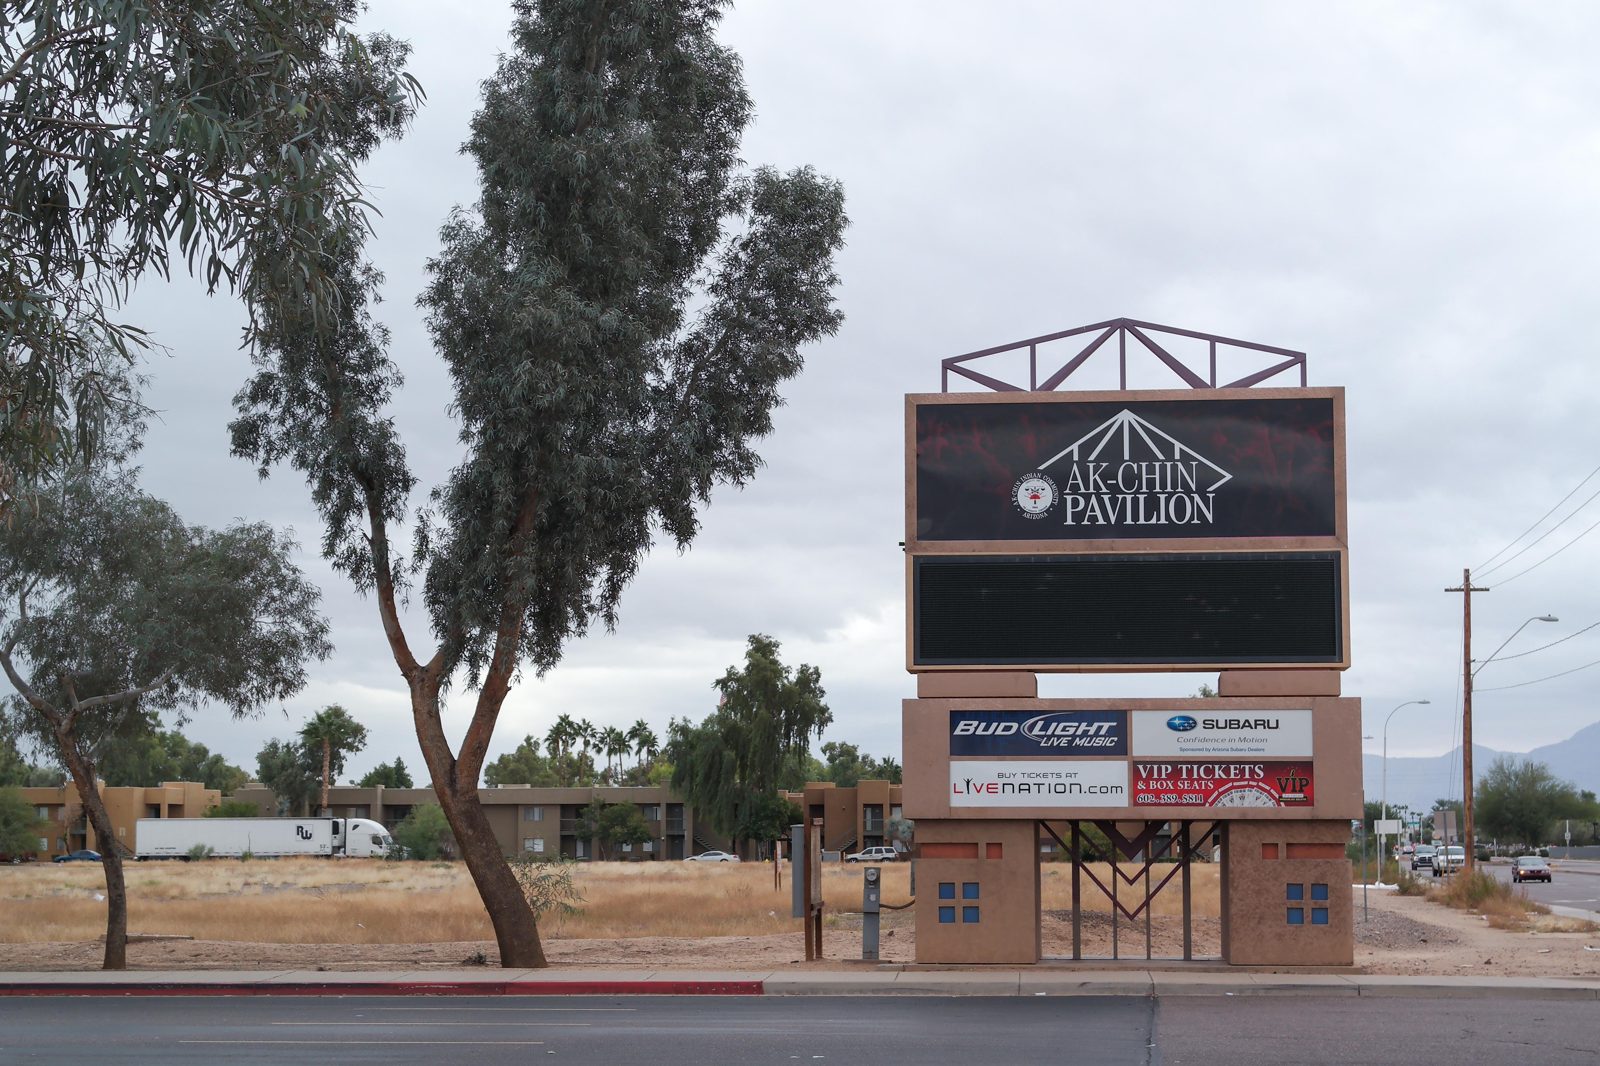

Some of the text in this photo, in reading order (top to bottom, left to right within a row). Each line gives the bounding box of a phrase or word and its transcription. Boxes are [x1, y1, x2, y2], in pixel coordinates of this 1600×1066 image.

[1064, 461, 1199, 494] AK-CHIN
[1020, 472, 1042, 482] INDIAN
[1042, 475, 1059, 506] COMMUNITY
[1022, 512, 1049, 520] ARIZONA
[1063, 493, 1216, 525] PAVILION
[953, 720, 1118, 736] BUD LIGHT
[1202, 719, 1279, 730] SUBARU
[1040, 736, 1118, 747] LIVE MUSIC
[1176, 736, 1268, 744] Confidence in Motion
[1137, 764, 1265, 779] VIP TICKETS
[1137, 780, 1214, 790] & BOX SEATS
[1276, 777, 1310, 793] VIP
